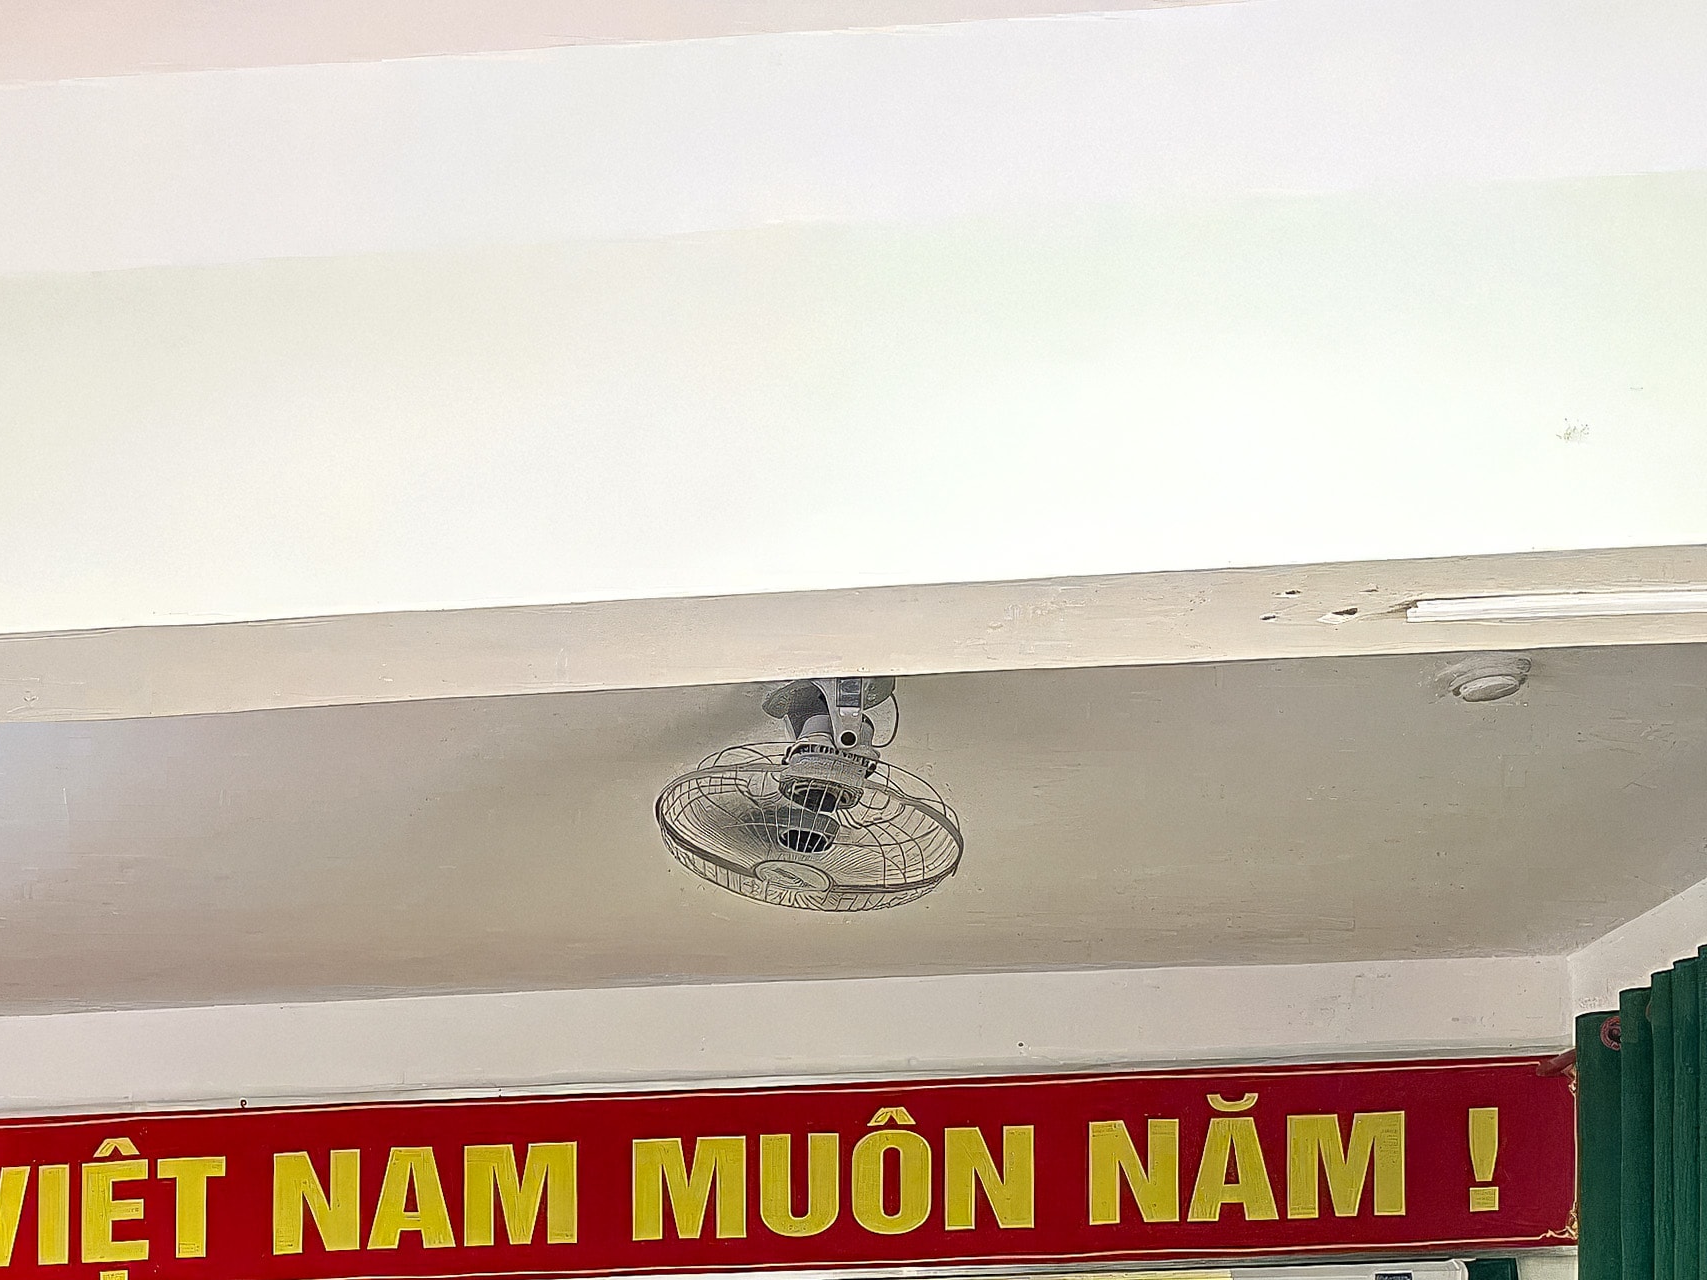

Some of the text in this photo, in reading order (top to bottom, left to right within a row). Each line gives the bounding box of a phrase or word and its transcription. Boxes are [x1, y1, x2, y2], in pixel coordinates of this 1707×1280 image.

[272, 1141, 579, 1256] NAM
[631, 1106, 1035, 1242] MUÔN
[1088, 1093, 1406, 1226] NĂM
[1468, 1106, 1500, 1213] !
